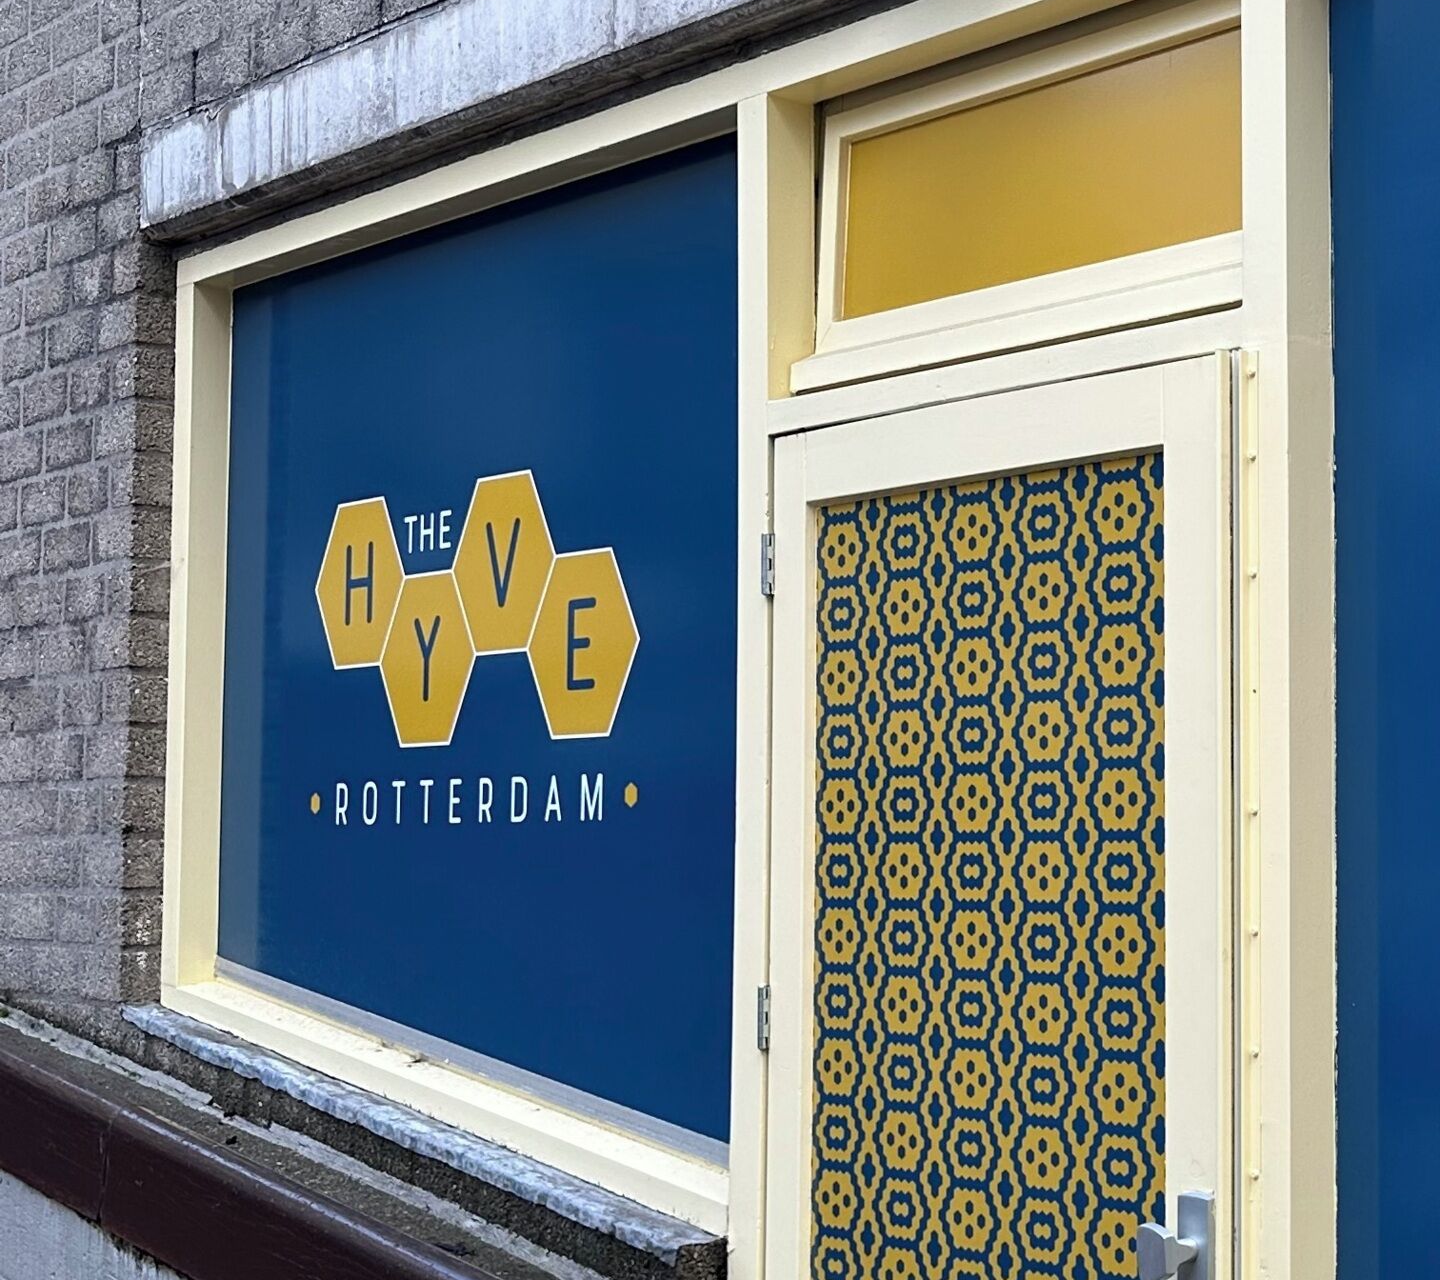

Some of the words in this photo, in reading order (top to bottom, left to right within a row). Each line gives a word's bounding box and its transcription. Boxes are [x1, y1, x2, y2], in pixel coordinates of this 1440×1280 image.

[404, 509, 453, 554] THE
[345, 517, 597, 702] HYVE
[335, 773, 603, 826] ROTTERDAM
